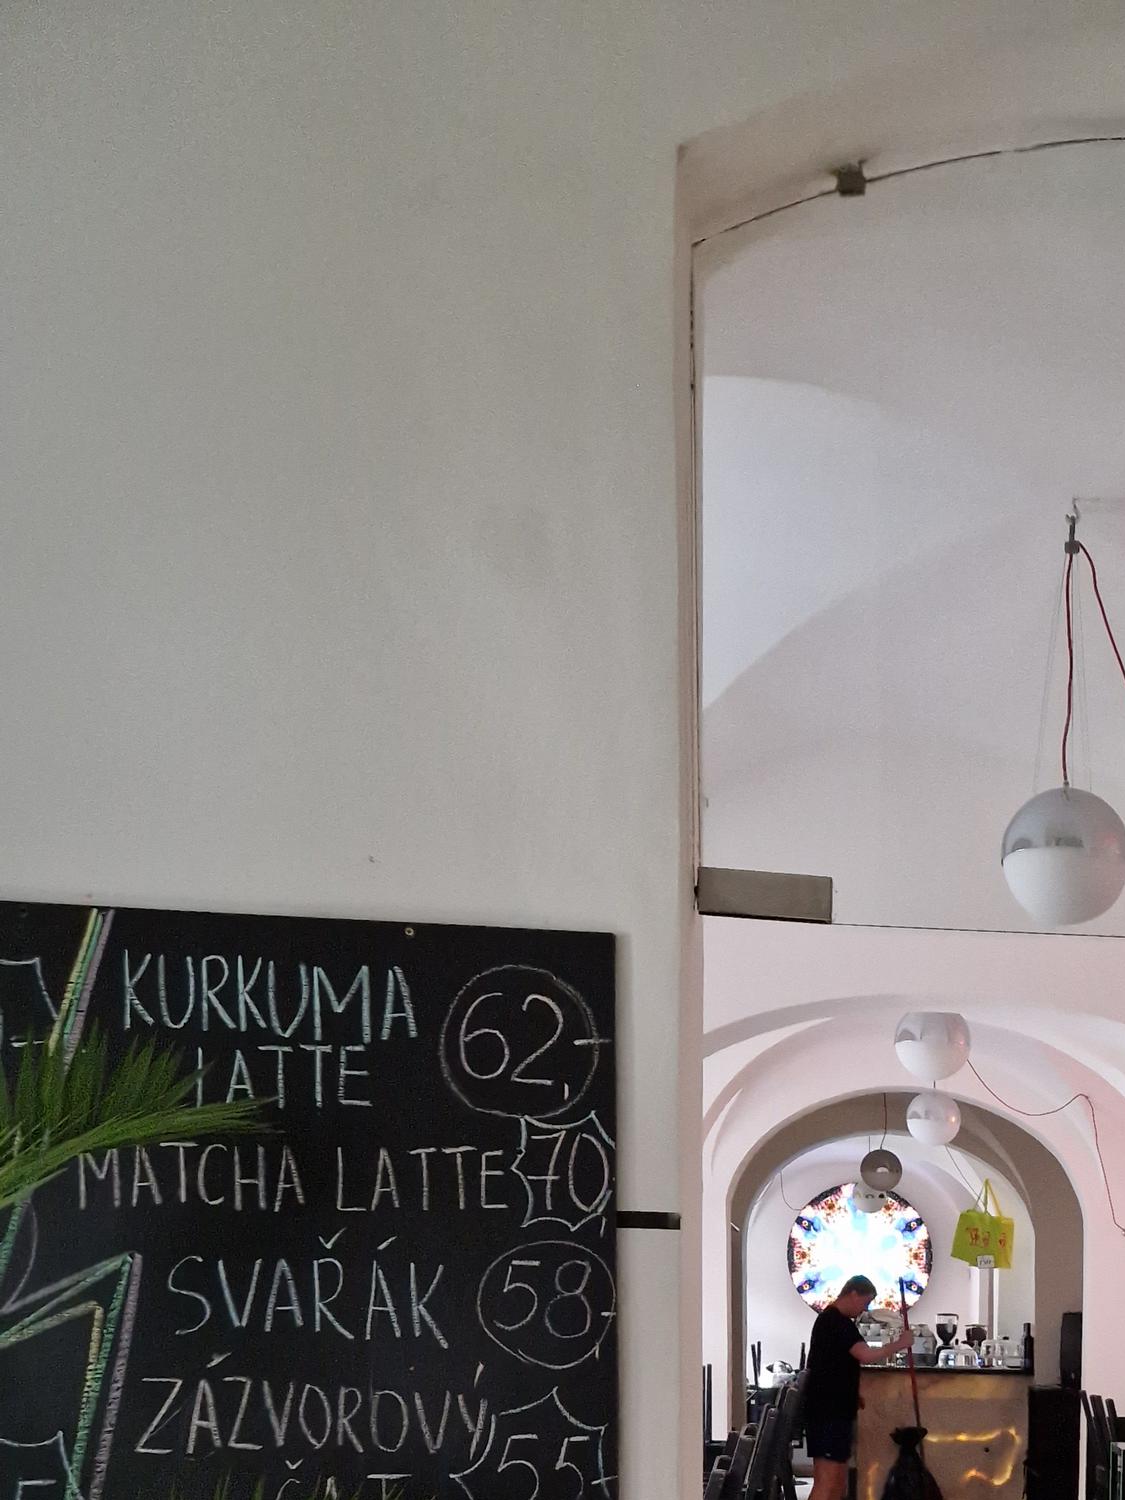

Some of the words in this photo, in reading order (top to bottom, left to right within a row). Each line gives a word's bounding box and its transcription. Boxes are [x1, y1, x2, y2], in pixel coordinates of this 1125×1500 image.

[122, 949, 418, 1044] KURKUMA
[79, 1142, 305, 1212] MATCHA
[336, 1146, 509, 1212] LATTE
[167, 1228, 449, 1350] SVAŘÁK
[135, 1352, 488, 1461] ZÁZVOROVÝ
